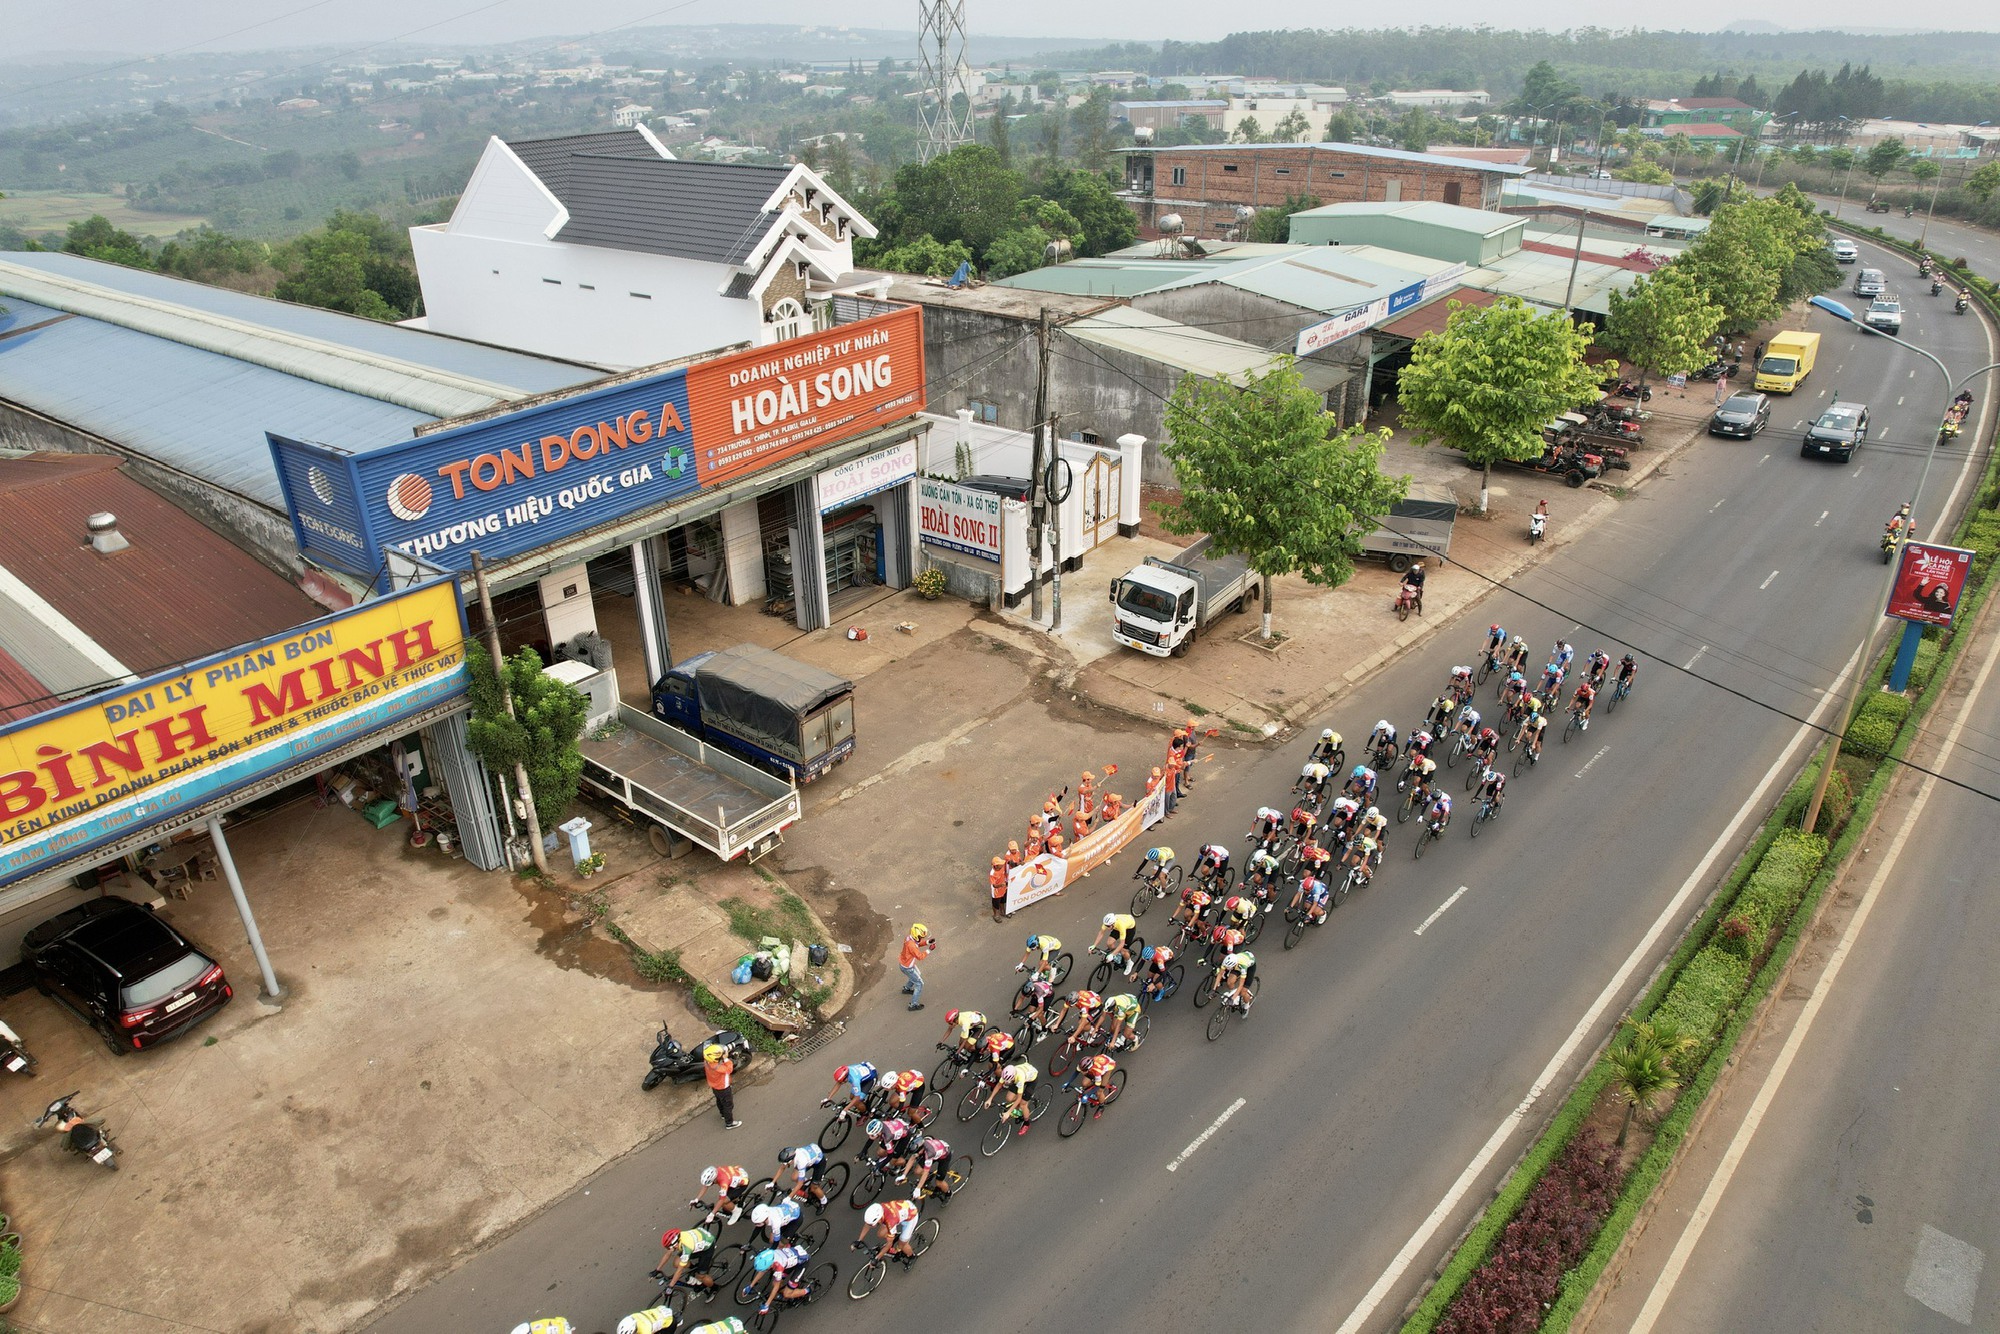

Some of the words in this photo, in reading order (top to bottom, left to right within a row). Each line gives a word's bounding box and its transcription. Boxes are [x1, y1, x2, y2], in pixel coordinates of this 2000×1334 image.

[1345, 305, 1369, 322] GARA
[729, 363, 780, 388] DOANH
[784, 345, 831, 371] NGHIỆP
[833, 340, 851, 357] TƯ
[854, 330, 889, 352] NHÂN
[731, 376, 809, 435] HOÀI
[815, 354, 892, 408] SONG
[438, 442, 535, 500] TON
[540, 409, 652, 472] DONG
[658, 402, 685, 438] A
[822, 470, 867, 498] HOÀI
[871, 452, 913, 478] SONG
[835, 465, 854, 477] CÔNG
[856, 460, 864, 470] TY
[867, 452, 885, 465] TNHH
[887, 446, 901, 458] MTV
[398, 513, 501, 556] THƯƠNG
[504, 494, 554, 527] HIỆU
[558, 474, 615, 510] QUỐC
[619, 464, 653, 489] GIA
[921, 504, 949, 535] HOÀI
[953, 515, 985, 545] SONG
[988, 525, 998, 548] II
[951, 489, 962, 505] TÔN
[984, 497, 999, 515] THÉP
[105, 694, 156, 724] ĐẠI
[166, 673, 194, 703] LÝ
[206, 649, 276, 688] PHÂN
[283, 629, 334, 660] BÓN
[0, 704, 217, 824] BÌNH
[241, 620, 440, 727] MINH
[48, 799, 92, 825] KINH
[95, 774, 154, 806] DOANH
[159, 755, 204, 780] PHÂN
[208, 739, 240, 762] BÓN
[244, 721, 284, 746] VTNN
[289, 716, 299, 729] &
[304, 696, 350, 722] THUỐC
[353, 684, 380, 704] BẢO
[382, 675, 399, 691] VỆ
[402, 662, 435, 683] THỰC
[437, 653, 457, 670] VẬT
[1012, 894, 1030, 906] TON
[1030, 887, 1052, 902] DONG
